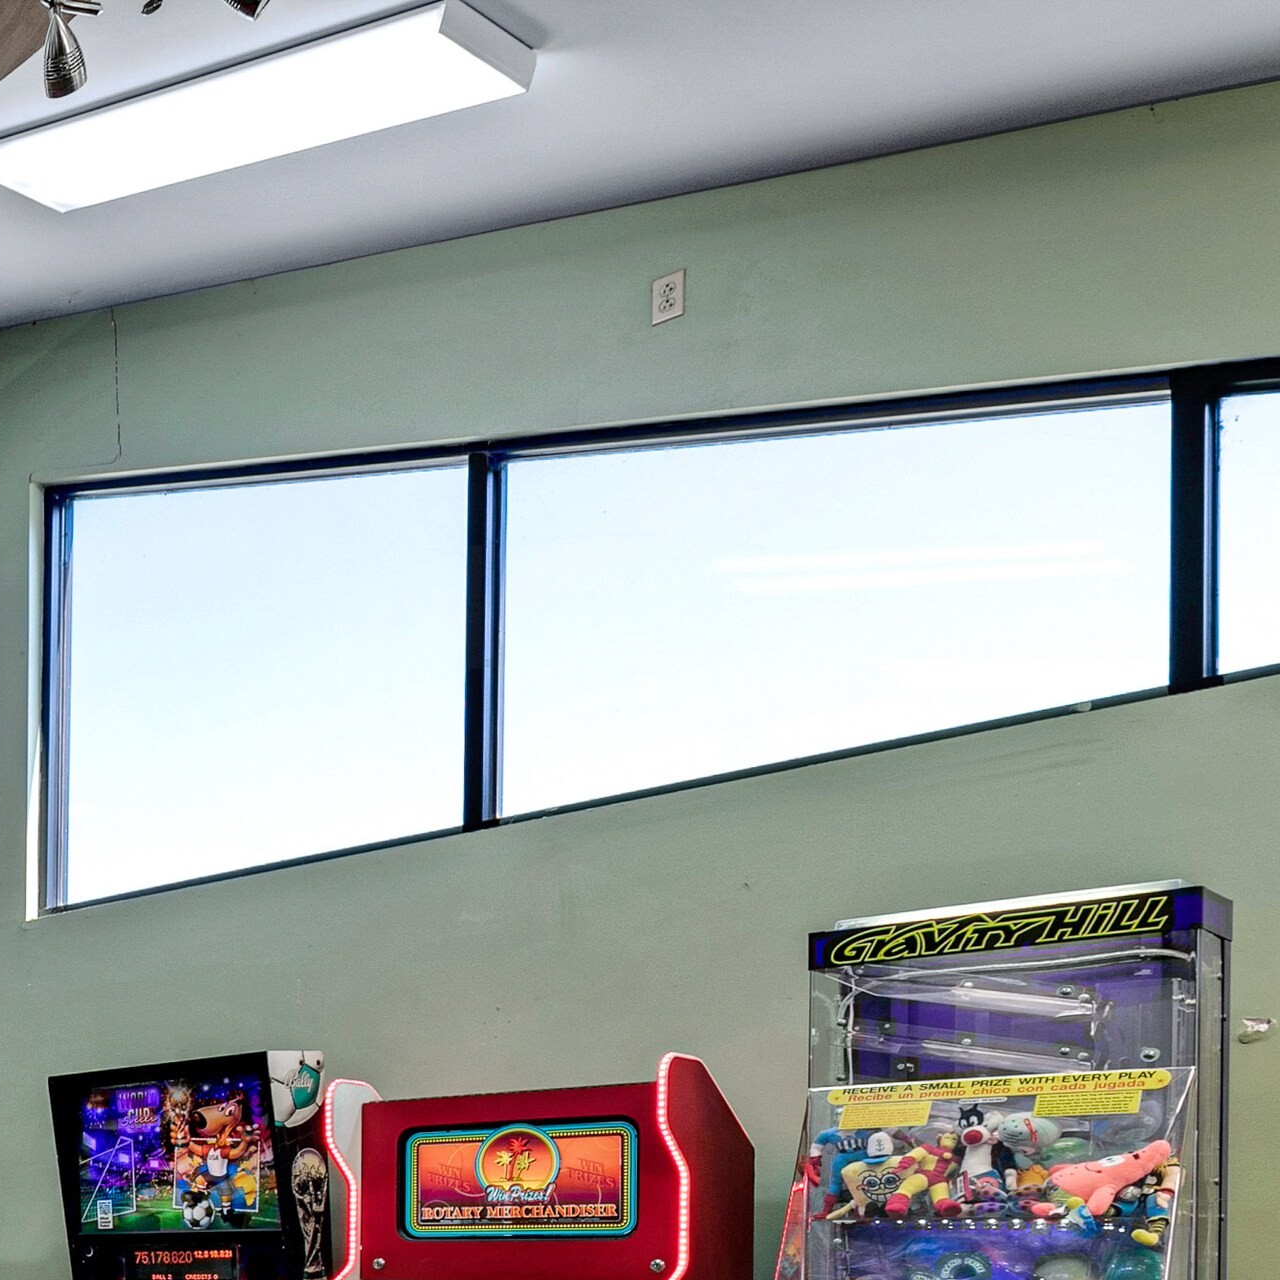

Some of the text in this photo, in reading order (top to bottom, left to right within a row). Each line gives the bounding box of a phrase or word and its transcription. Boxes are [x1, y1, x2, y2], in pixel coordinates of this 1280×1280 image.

[842, 1068, 1158, 1096] RECEIVE A SMALL PRIZE WITH EVERY PLAY
[848, 1092, 891, 1102] Recibe
[919, 1088, 967, 1100] premio
[972, 1085, 1010, 1095] chico
[1050, 1080, 1087, 1091] cada
[1092, 1078, 1146, 1092] jugada
[422, 1203, 618, 1220] ROTARY MERCHANDISER
